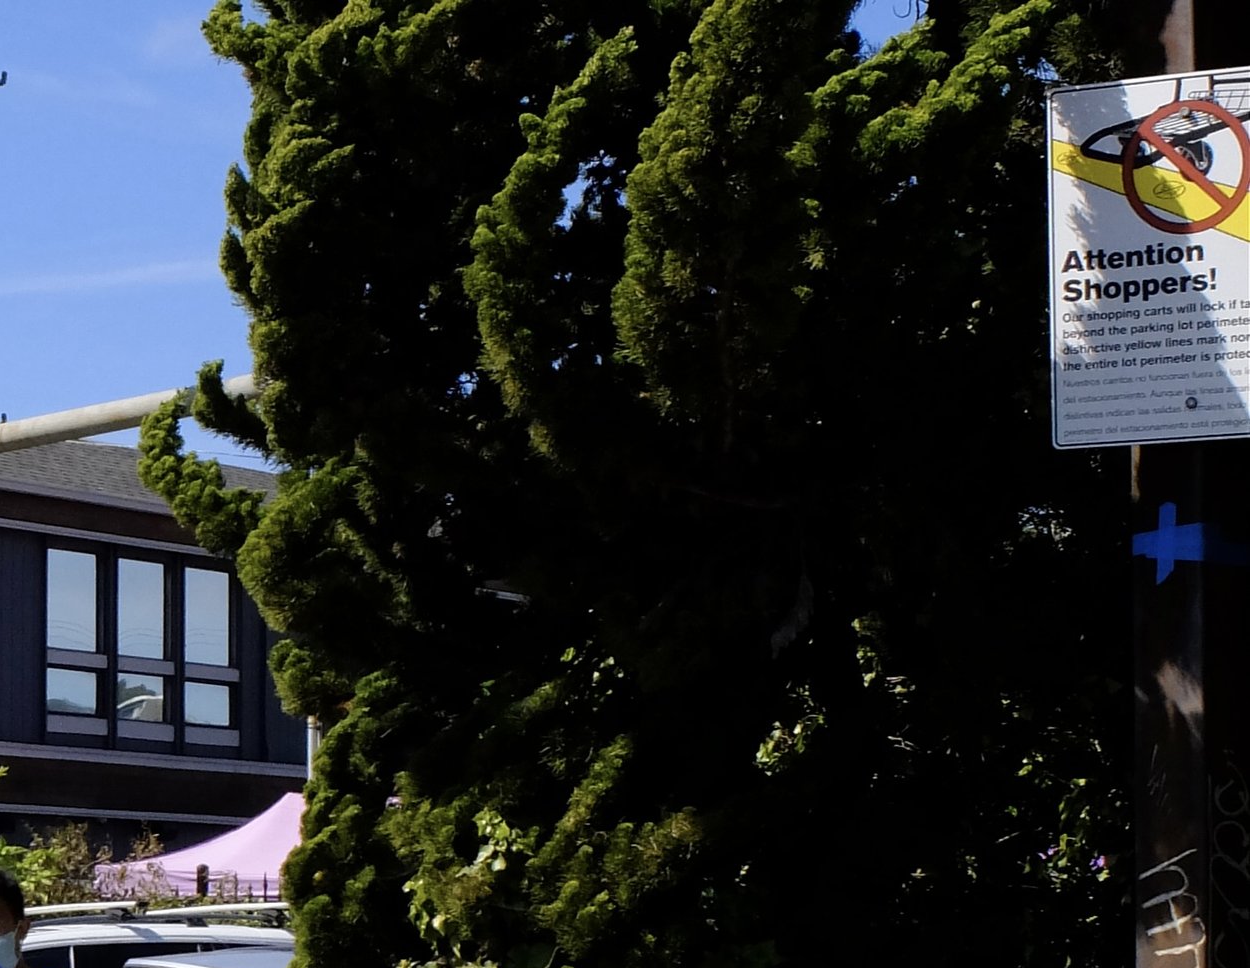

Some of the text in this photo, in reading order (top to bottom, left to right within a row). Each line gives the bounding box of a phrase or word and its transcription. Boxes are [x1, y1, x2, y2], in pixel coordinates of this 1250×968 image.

[1061, 242, 1204, 273] Attention
[1062, 267, 1217, 303] Shoppers!
[1063, 313, 1084, 323] Our
[1087, 307, 1140, 322] shopping
[1144, 306, 1173, 317] carts
[1177, 303, 1196, 314] will
[1200, 301, 1225, 312] lock
[1229, 300, 1237, 309] if
[1063, 328, 1104, 340] beyond
[1109, 326, 1127, 335] the
[1131, 322, 1174, 335] parking
[1177, 320, 1193, 330] lot
[1063, 343, 1121, 355] distinctive
[1124, 339, 1162, 351] yellow
[1165, 337, 1193, 347] lines
[1197, 335, 1227, 345] mark
[1063, 362, 1081, 372] the
[1085, 358, 1118, 369] entire
[1121, 356, 1137, 367] lot
[1140, 353, 1197, 368] perimeter
[1201, 352, 1211, 362] is
